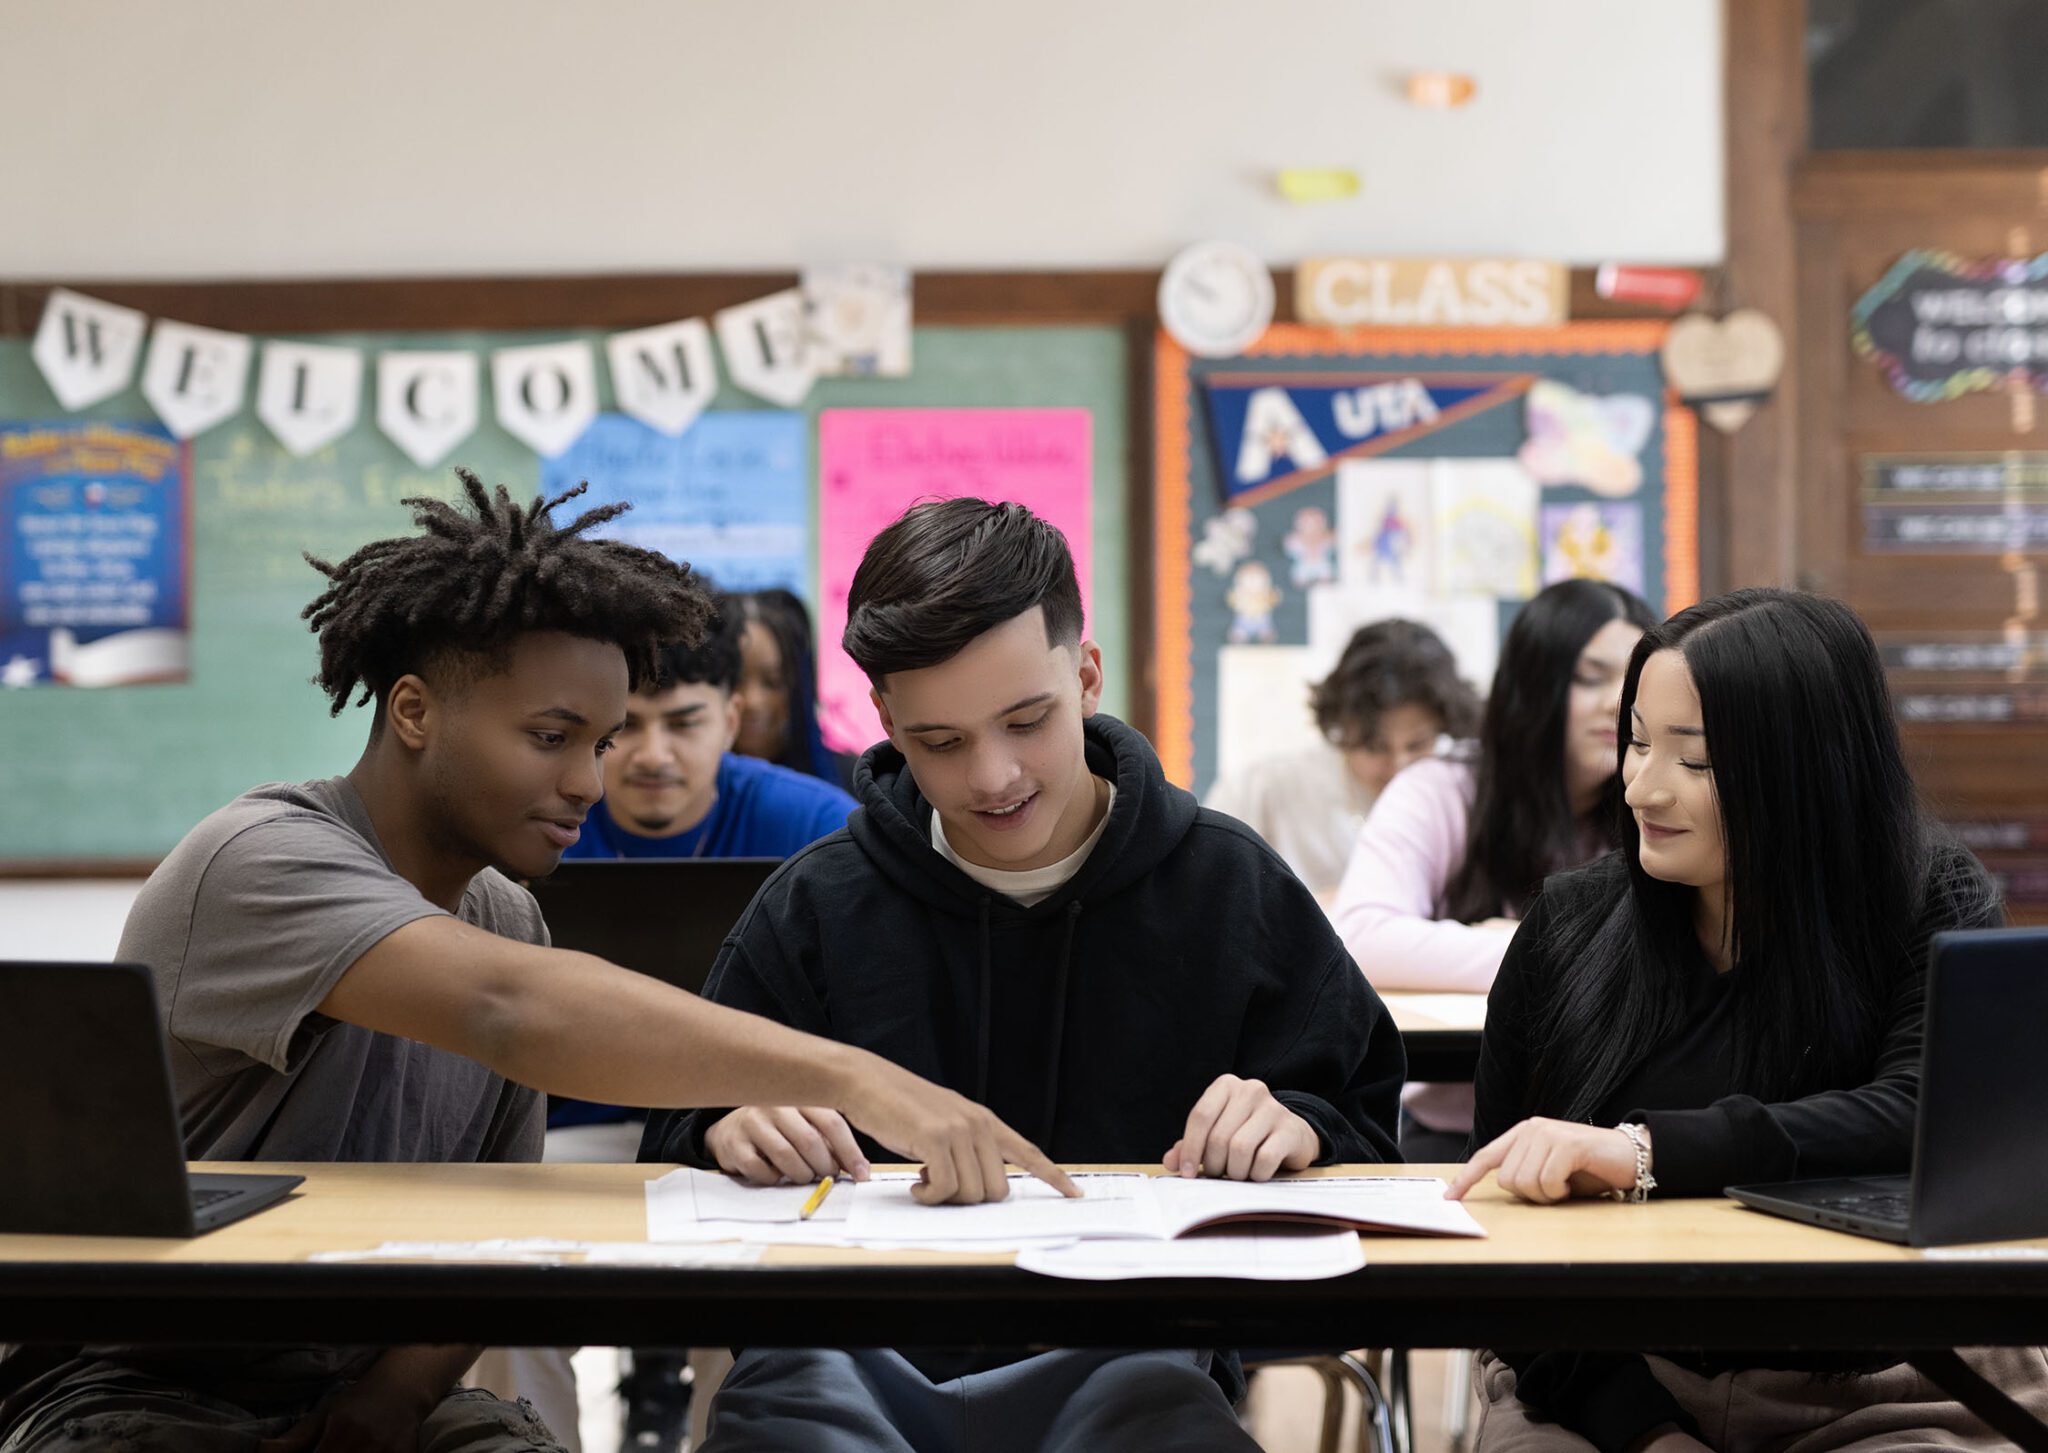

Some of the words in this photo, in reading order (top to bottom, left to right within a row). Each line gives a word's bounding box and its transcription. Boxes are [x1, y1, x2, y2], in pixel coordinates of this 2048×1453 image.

[1313, 259, 1550, 324] CLASS
[1236, 386, 1329, 484] A
[1331, 377, 1441, 440] UTA
